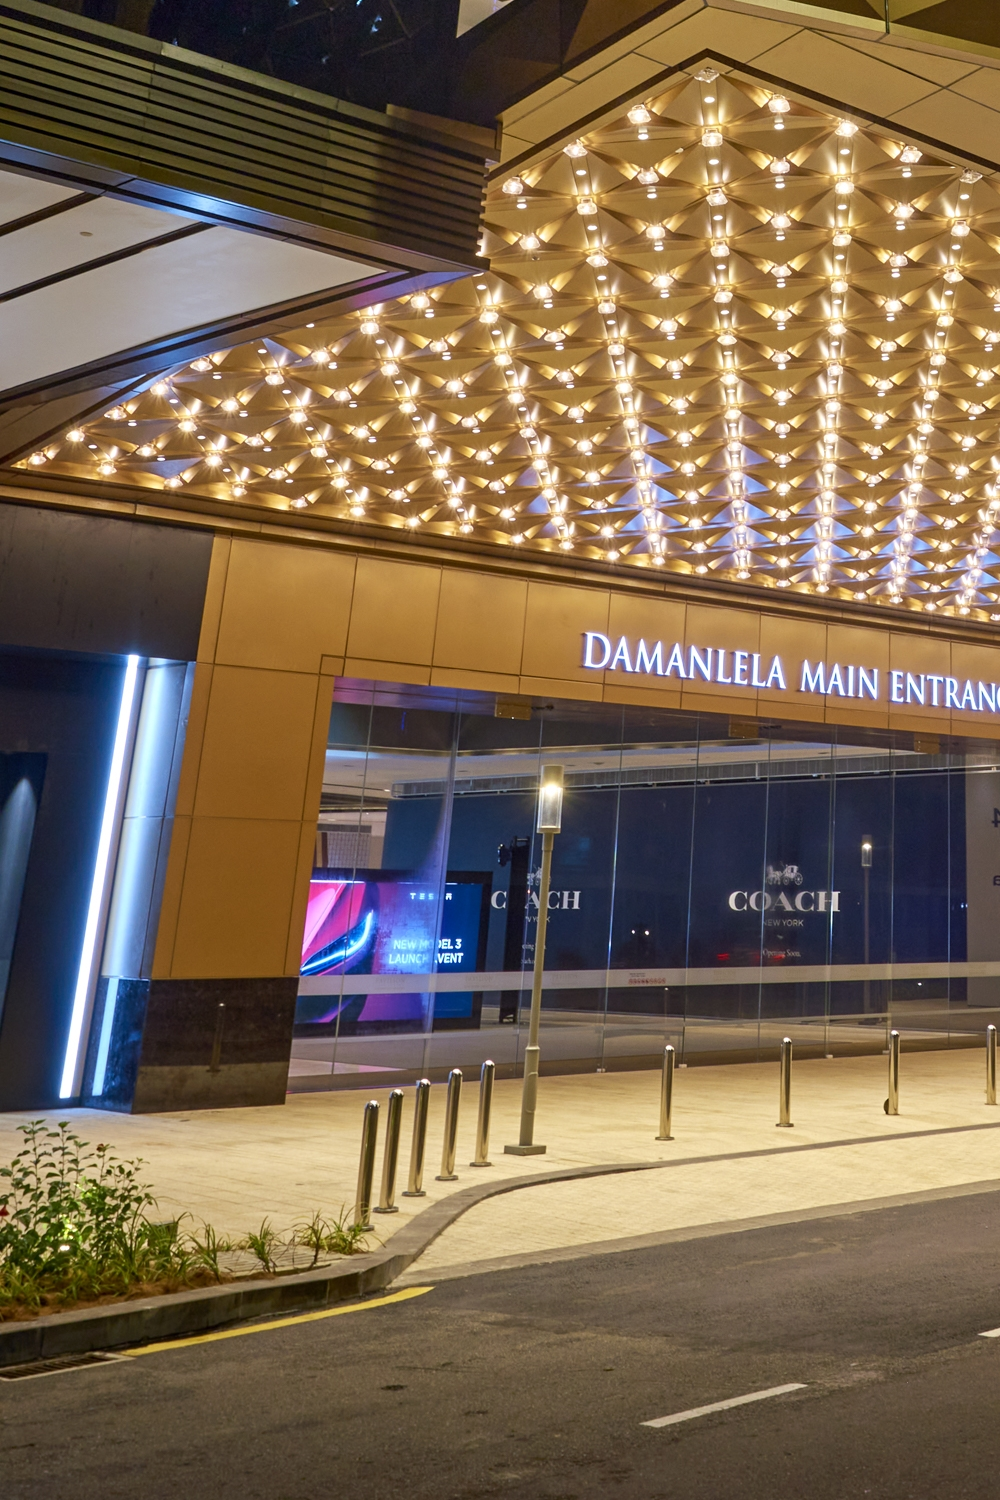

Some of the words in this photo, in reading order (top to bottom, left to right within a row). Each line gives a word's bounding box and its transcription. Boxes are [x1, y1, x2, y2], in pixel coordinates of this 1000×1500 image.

[581, 631, 787, 690] DAMANLELA
[800, 658, 880, 699] MAIN
[410, 892, 453, 900] TESA
[491, 890, 582, 910] CACH
[728, 890, 841, 912] COACH
[782, 919, 804, 927] YORK
[393, 939, 417, 950] NEW
[454, 939, 462, 950] 3
